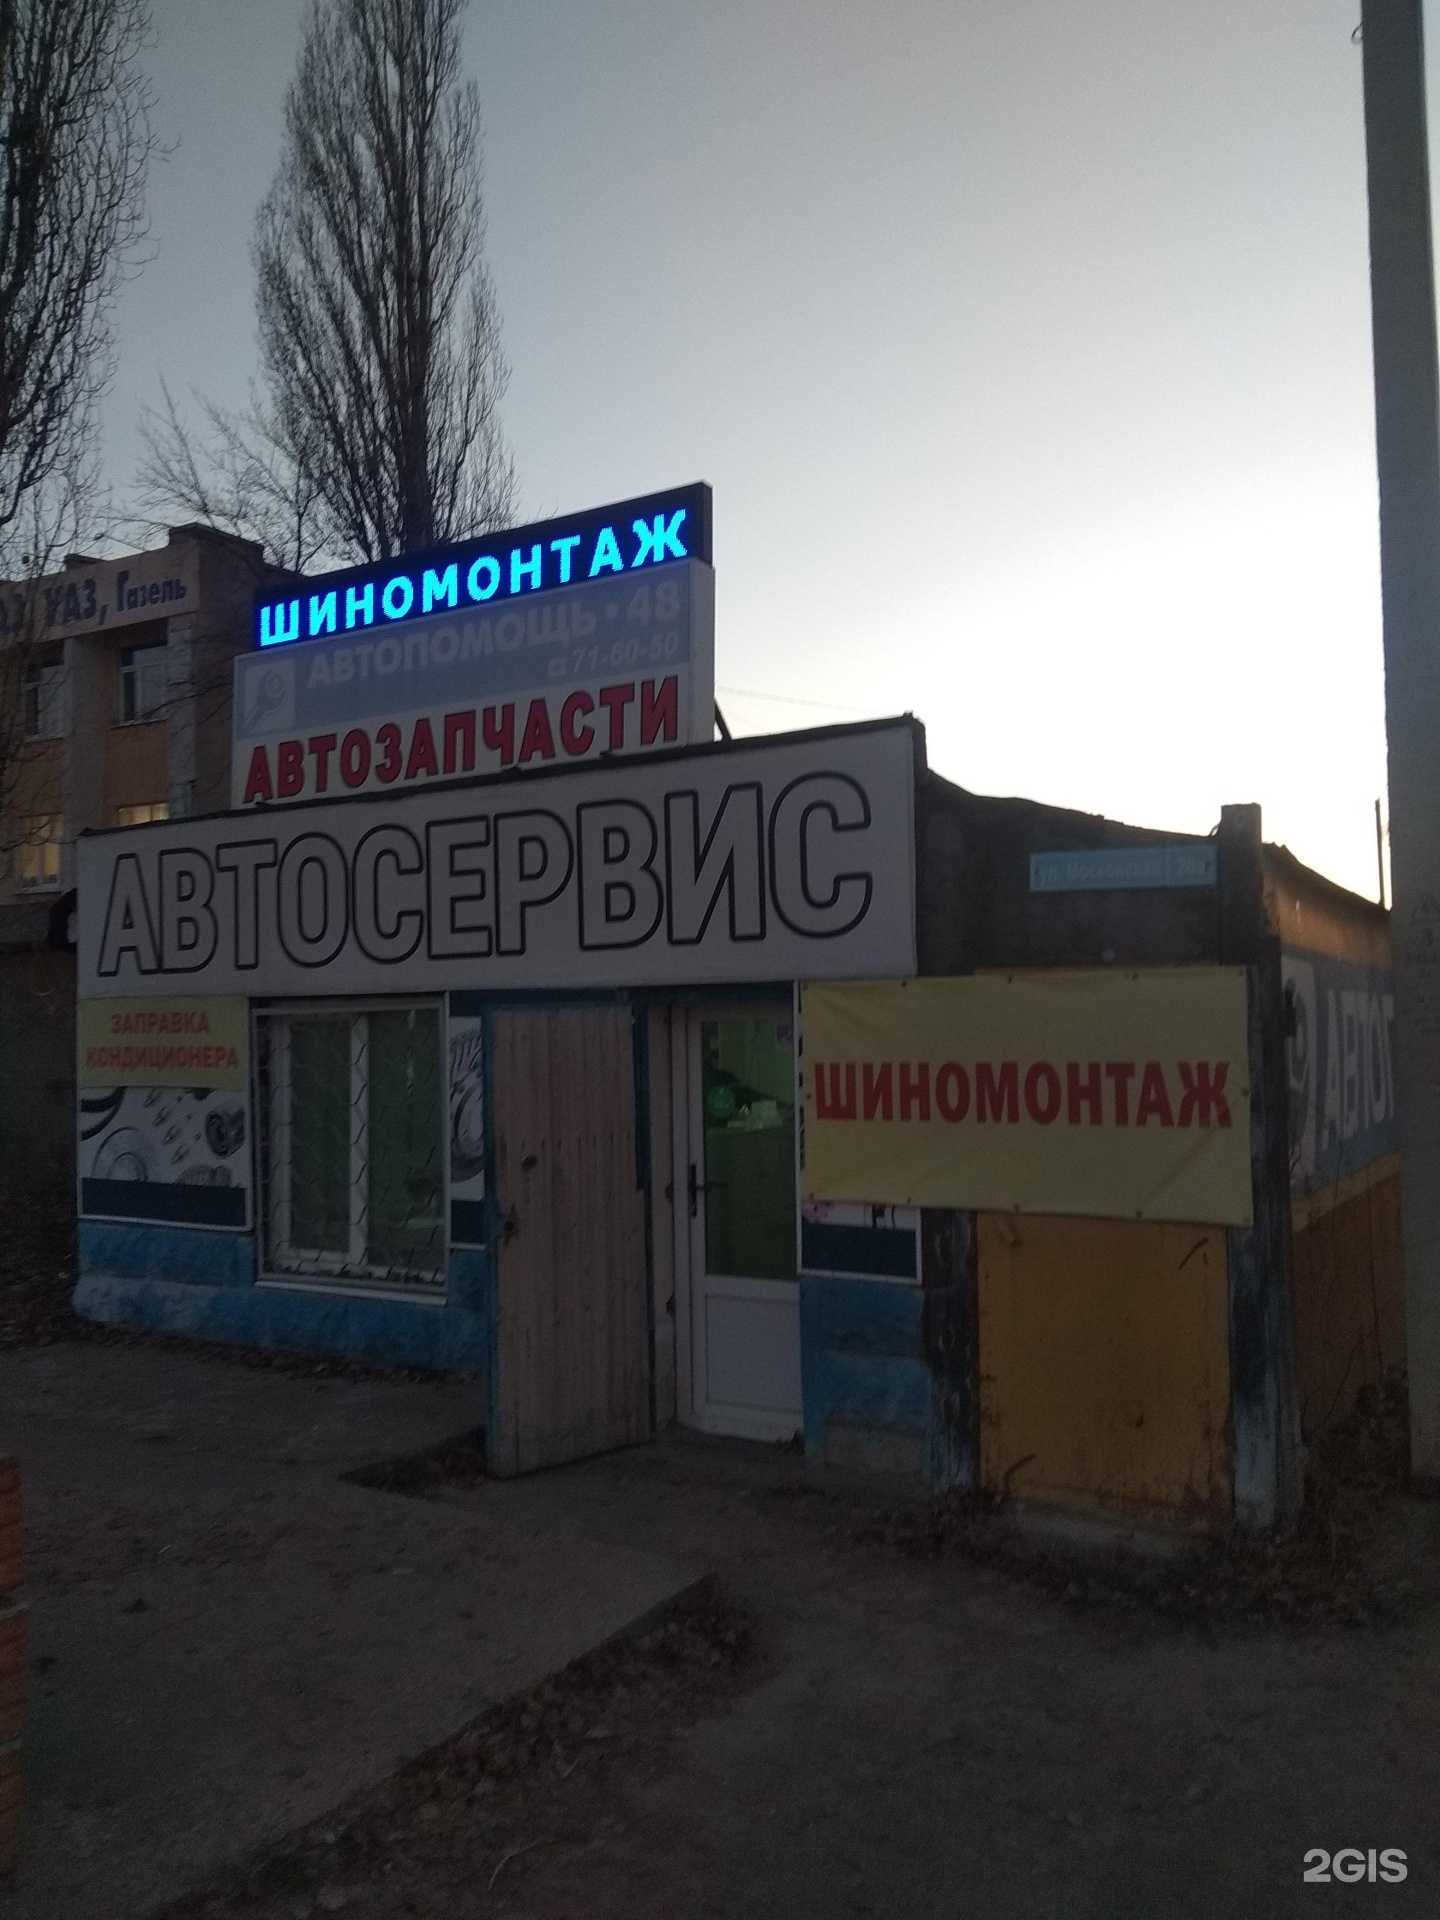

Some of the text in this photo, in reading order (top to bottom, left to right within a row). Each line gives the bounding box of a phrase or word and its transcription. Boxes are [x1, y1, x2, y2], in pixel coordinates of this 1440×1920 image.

[117, 570, 187, 612] Газель
[258, 507, 689, 648] ШИНОМОНТАЖ
[307, 579, 681, 688] АВТОПОМОЩЬ 48
[243, 675, 680, 804] АВТОЗАПЧАСТИ
[98, 771, 872, 976] АВТОСЕРВИС
[86, 1044, 240, 1070] КОНДИЦИОНЕРА
[111, 1011, 209, 1035] ЗАПРАВКА
[814, 1060, 1233, 1130] ШИНОМОНТАЖ
